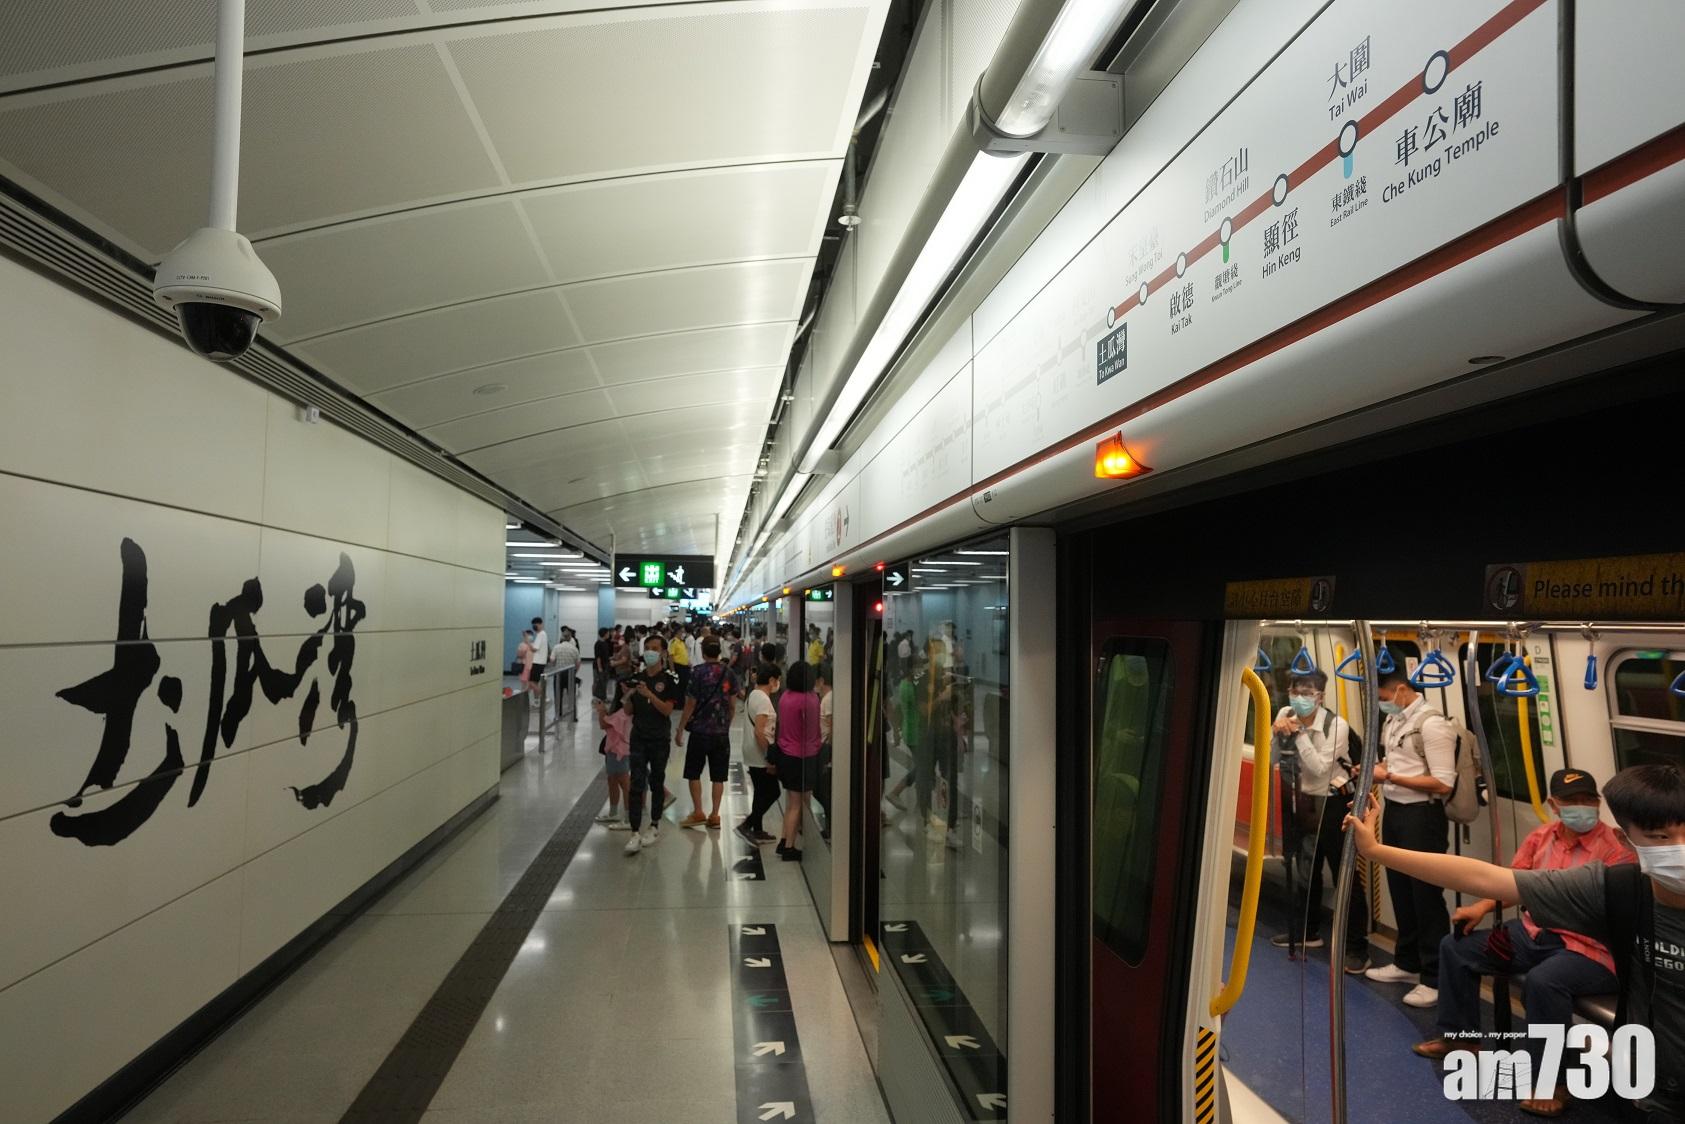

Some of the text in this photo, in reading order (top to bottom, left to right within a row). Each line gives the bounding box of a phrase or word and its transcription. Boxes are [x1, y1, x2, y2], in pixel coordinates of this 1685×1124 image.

[1327, 35, 1371, 102] 大圍
[1328, 78, 1368, 121] Tai Wai
[1394, 80, 1482, 167] 車公廟
[1382, 120, 1500, 203] Che Kung Temple
[1204, 175, 1249, 224] Diamond Hill
[1330, 198, 1369, 228] East Rail Line
[1263, 206, 1299, 259] 顯徑
[1262, 246, 1301, 280] Hin Keng
[1171, 313, 1193, 335] Kai Tak
[1098, 328, 1125, 366] 土瓜灣
[1099, 368, 1105, 380] To
[1104, 364, 1115, 377] Kwa
[1114, 358, 1125, 371] Wan
[1533, 577, 1593, 599] Please
[1599, 574, 1654, 597] mind
